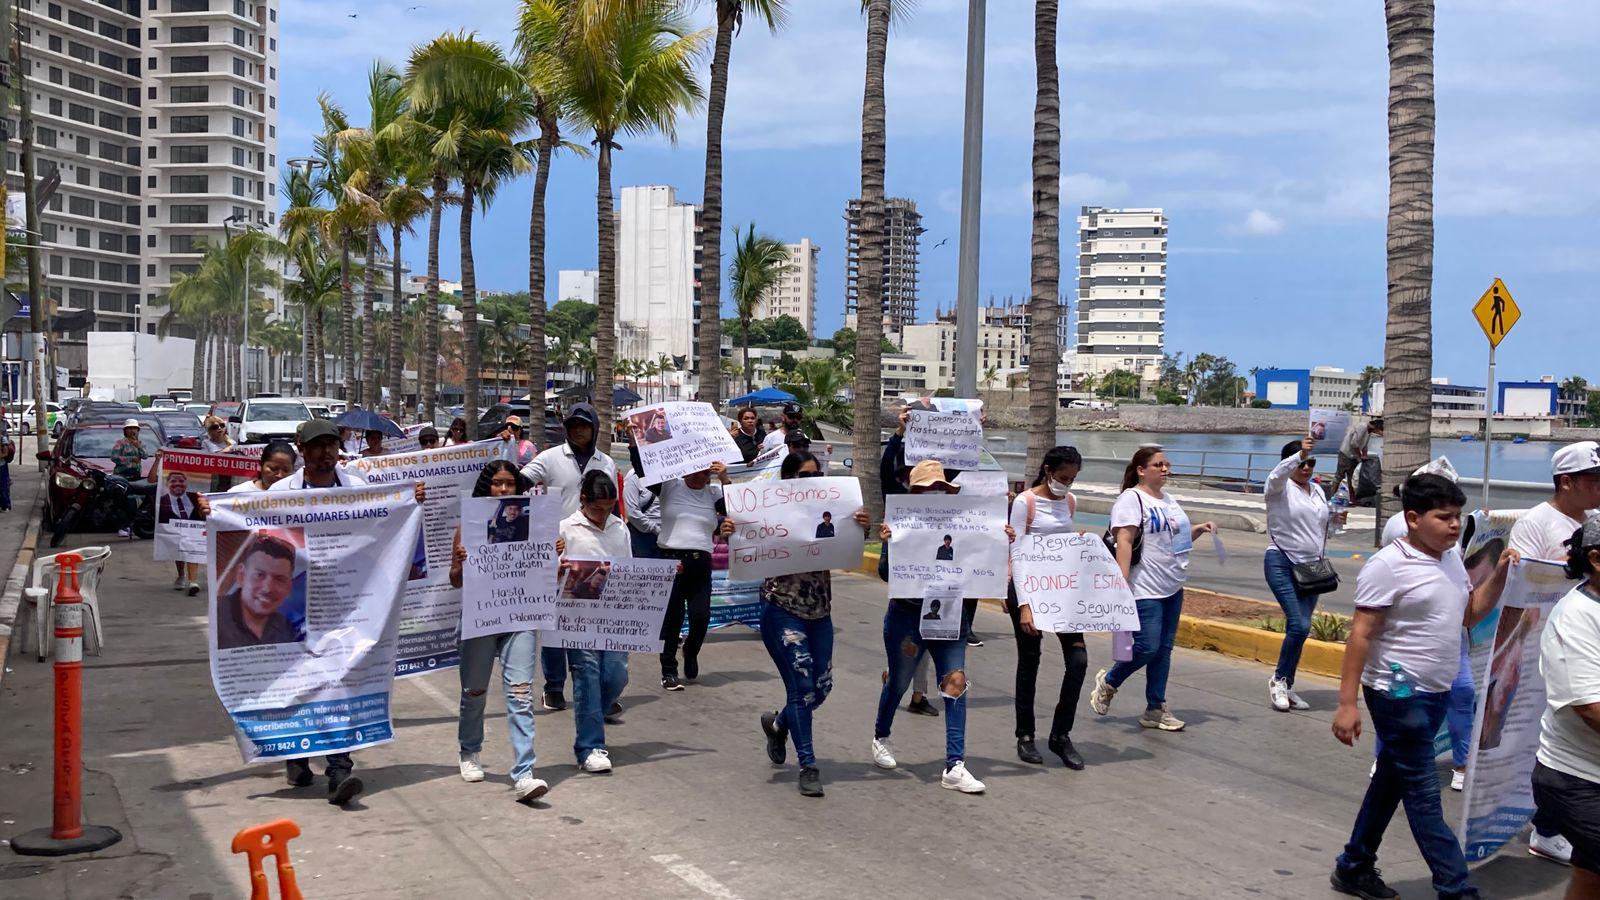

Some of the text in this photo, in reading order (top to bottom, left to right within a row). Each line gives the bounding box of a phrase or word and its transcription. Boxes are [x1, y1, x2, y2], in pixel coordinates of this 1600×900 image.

[164, 453, 202, 466] PRIVADO
[203, 457, 215, 467] DE
[217, 458, 229, 468] SU
[421, 454, 429, 464] a
[432, 448, 490, 462] encontrar
[492, 446, 501, 456] a
[368, 471, 401, 484] DANIEL
[402, 466, 457, 481] PALOMARES
[309, 496, 318, 506] a
[322, 490, 388, 506] encontrar
[393, 490, 401, 501] a
[727, 488, 757, 513] NO
[245, 507, 389, 527] DANIEL PALOMARES LLANES
[1149, 506, 1172, 534] NA
[478, 541, 554, 555] Que nuestros
[501, 552, 514, 562] de
[491, 586, 525, 599] Hasta
[477, 594, 556, 611] Encontrarte
[1077, 600, 1135, 619] Seguimos
[475, 612, 554, 629] Daniel Palomares
[277, 741, 296, 751] 8424
